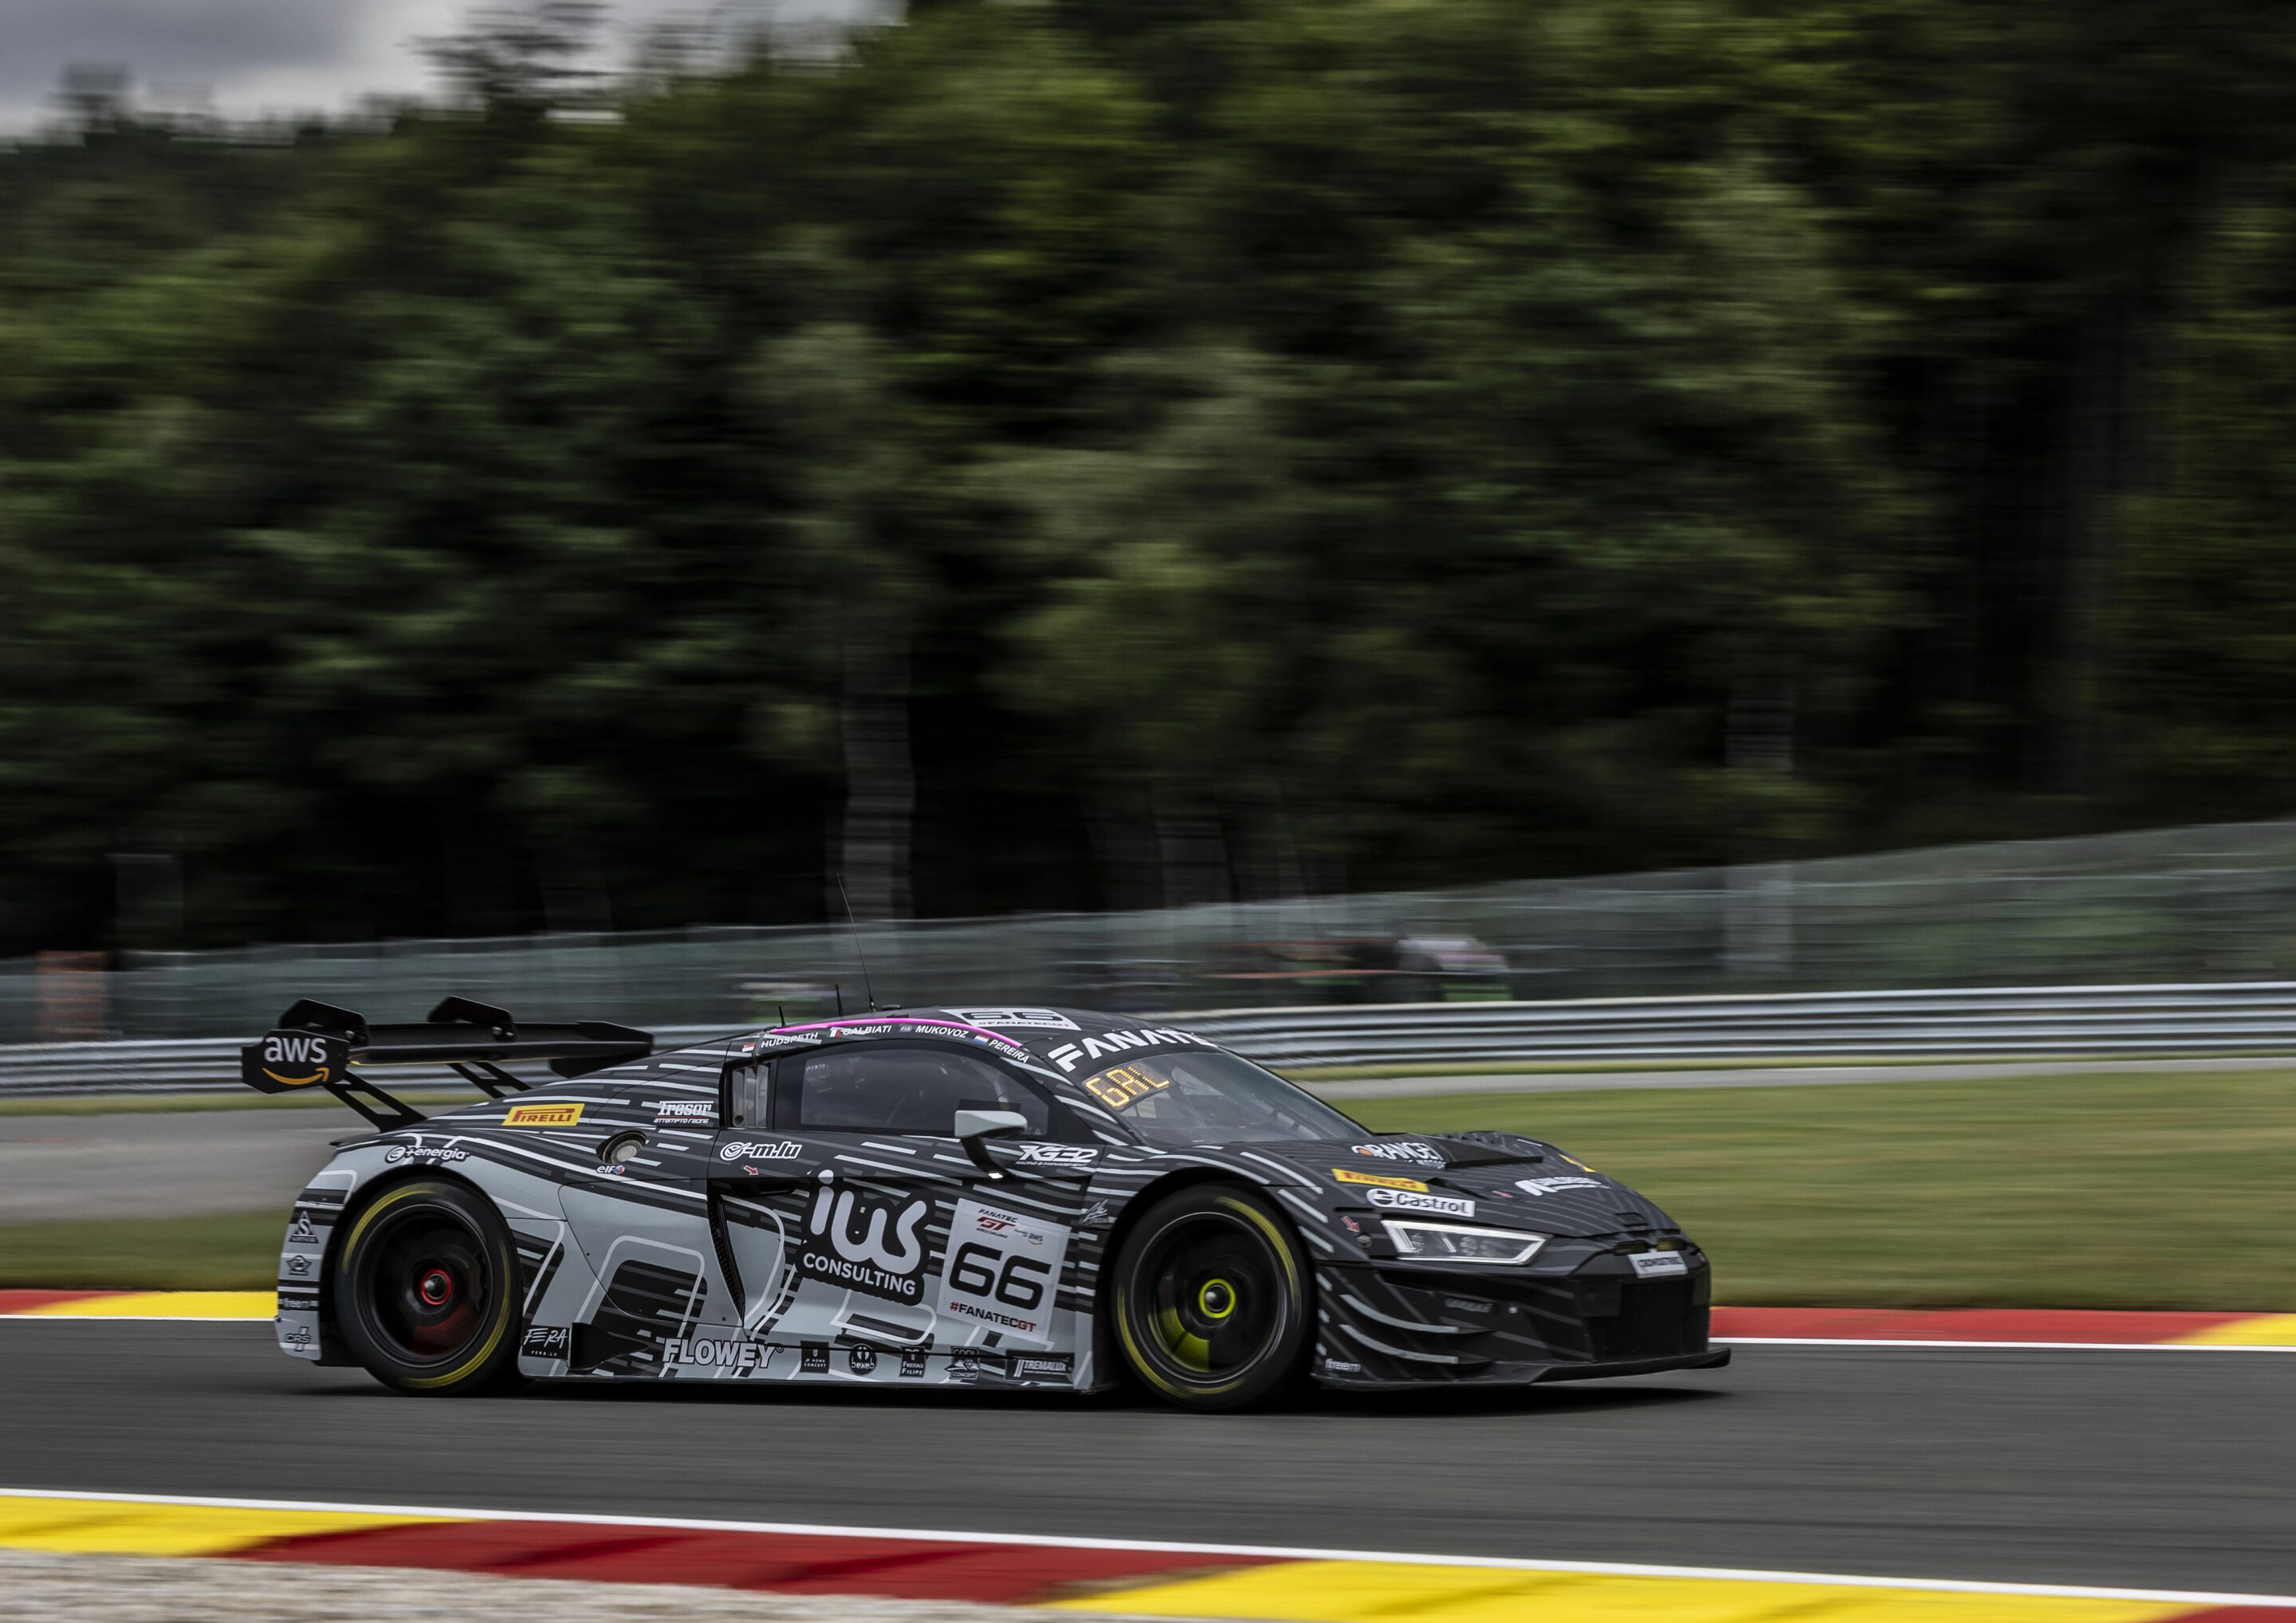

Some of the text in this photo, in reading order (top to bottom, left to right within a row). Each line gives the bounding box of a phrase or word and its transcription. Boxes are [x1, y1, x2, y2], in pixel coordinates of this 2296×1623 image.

[961, 1012, 1063, 1021] 66
[842, 1025, 892, 1035] GALBIATI
[915, 1025, 969, 1038] MUKOVOZ
[761, 1032, 819, 1048] HUDSPETH
[264, 1037, 327, 1063] aws
[989, 1039, 1029, 1063] PEREIRA
[512, 1108, 576, 1122] PIRELLI
[658, 1101, 714, 1116] Tresor
[1397, 1193, 1468, 1213] Castrol
[978, 1208, 1019, 1223] FANATEC
[804, 1252, 916, 1295] CONSULTING
[949, 1241, 1052, 1311] 66
[949, 1301, 1036, 1332] #FANATECGT
[662, 1339, 775, 1369] FLOWEY
